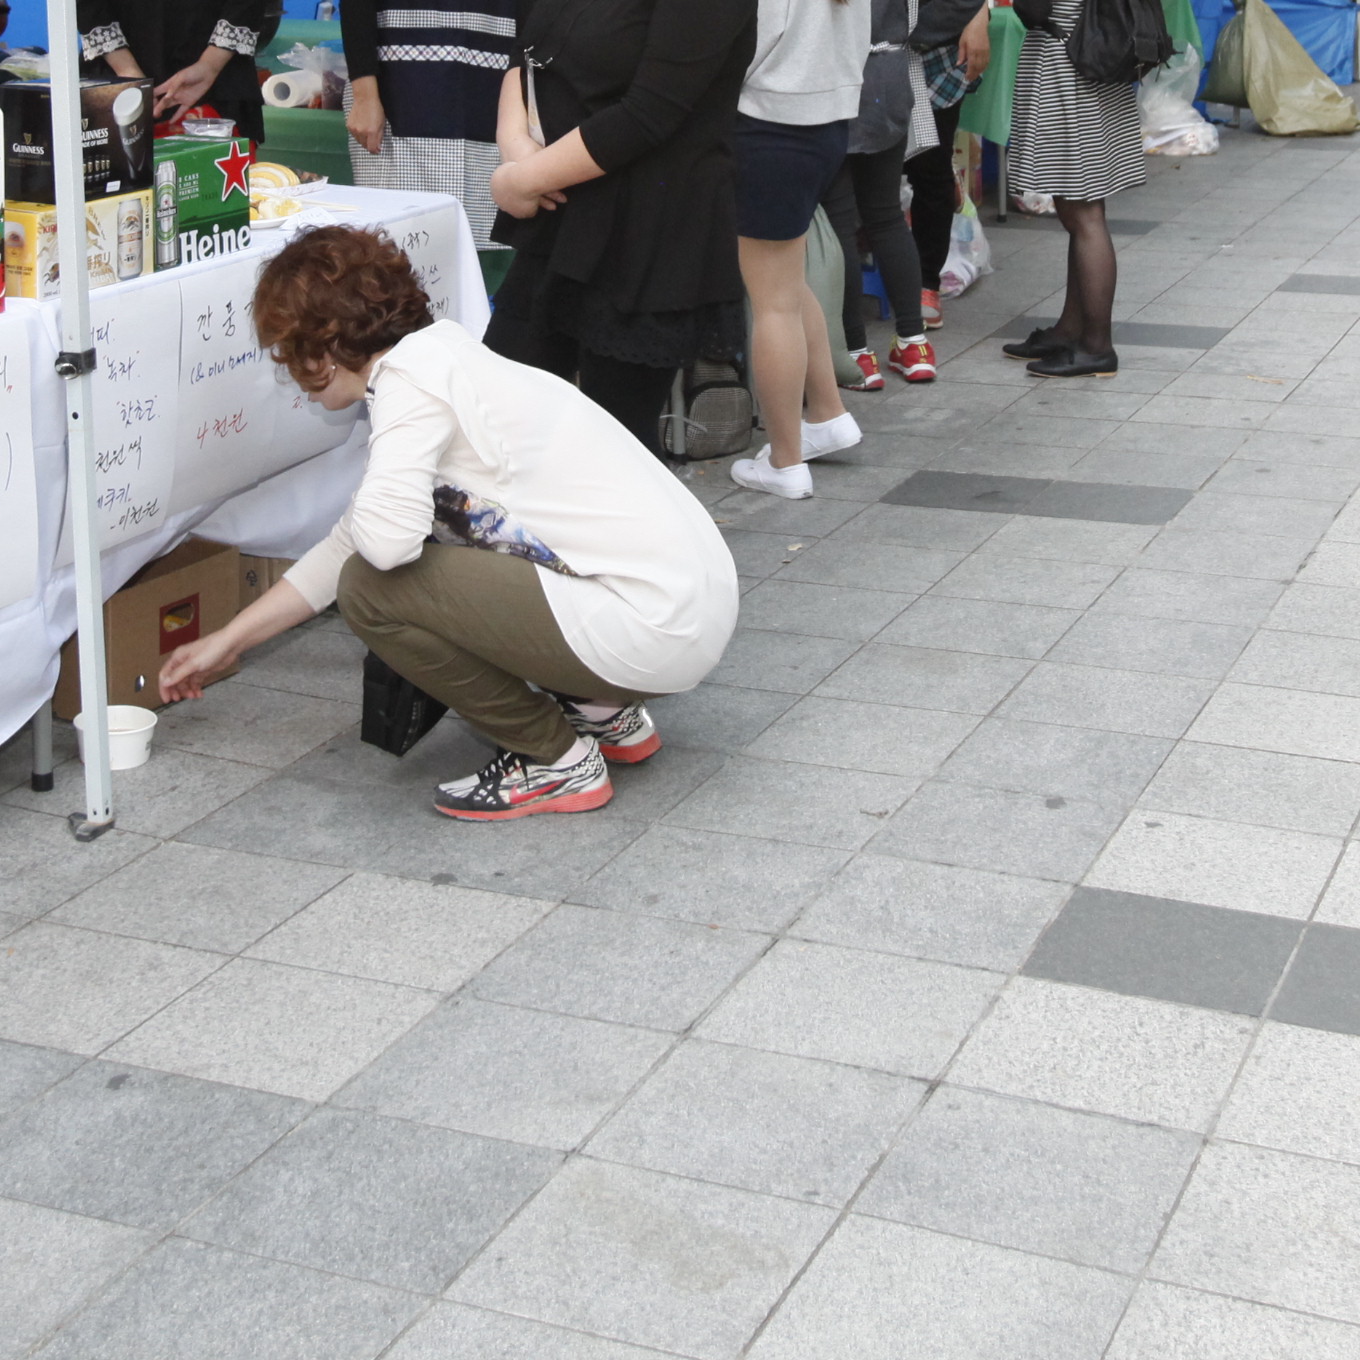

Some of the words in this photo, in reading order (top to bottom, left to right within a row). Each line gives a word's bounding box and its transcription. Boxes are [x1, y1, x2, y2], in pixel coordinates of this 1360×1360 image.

[81, 127, 109, 142] UINNESS
[12, 142, 45, 155] GUINNESS
[42, 222, 58, 235] KIRI
[179, 223, 251, 265] Heine
[106, 356, 137, 384] 녹차
[208, 359, 227, 377] 미니
[120, 400, 157, 429] 핫초코
[196, 408, 248, 449] 4천원
